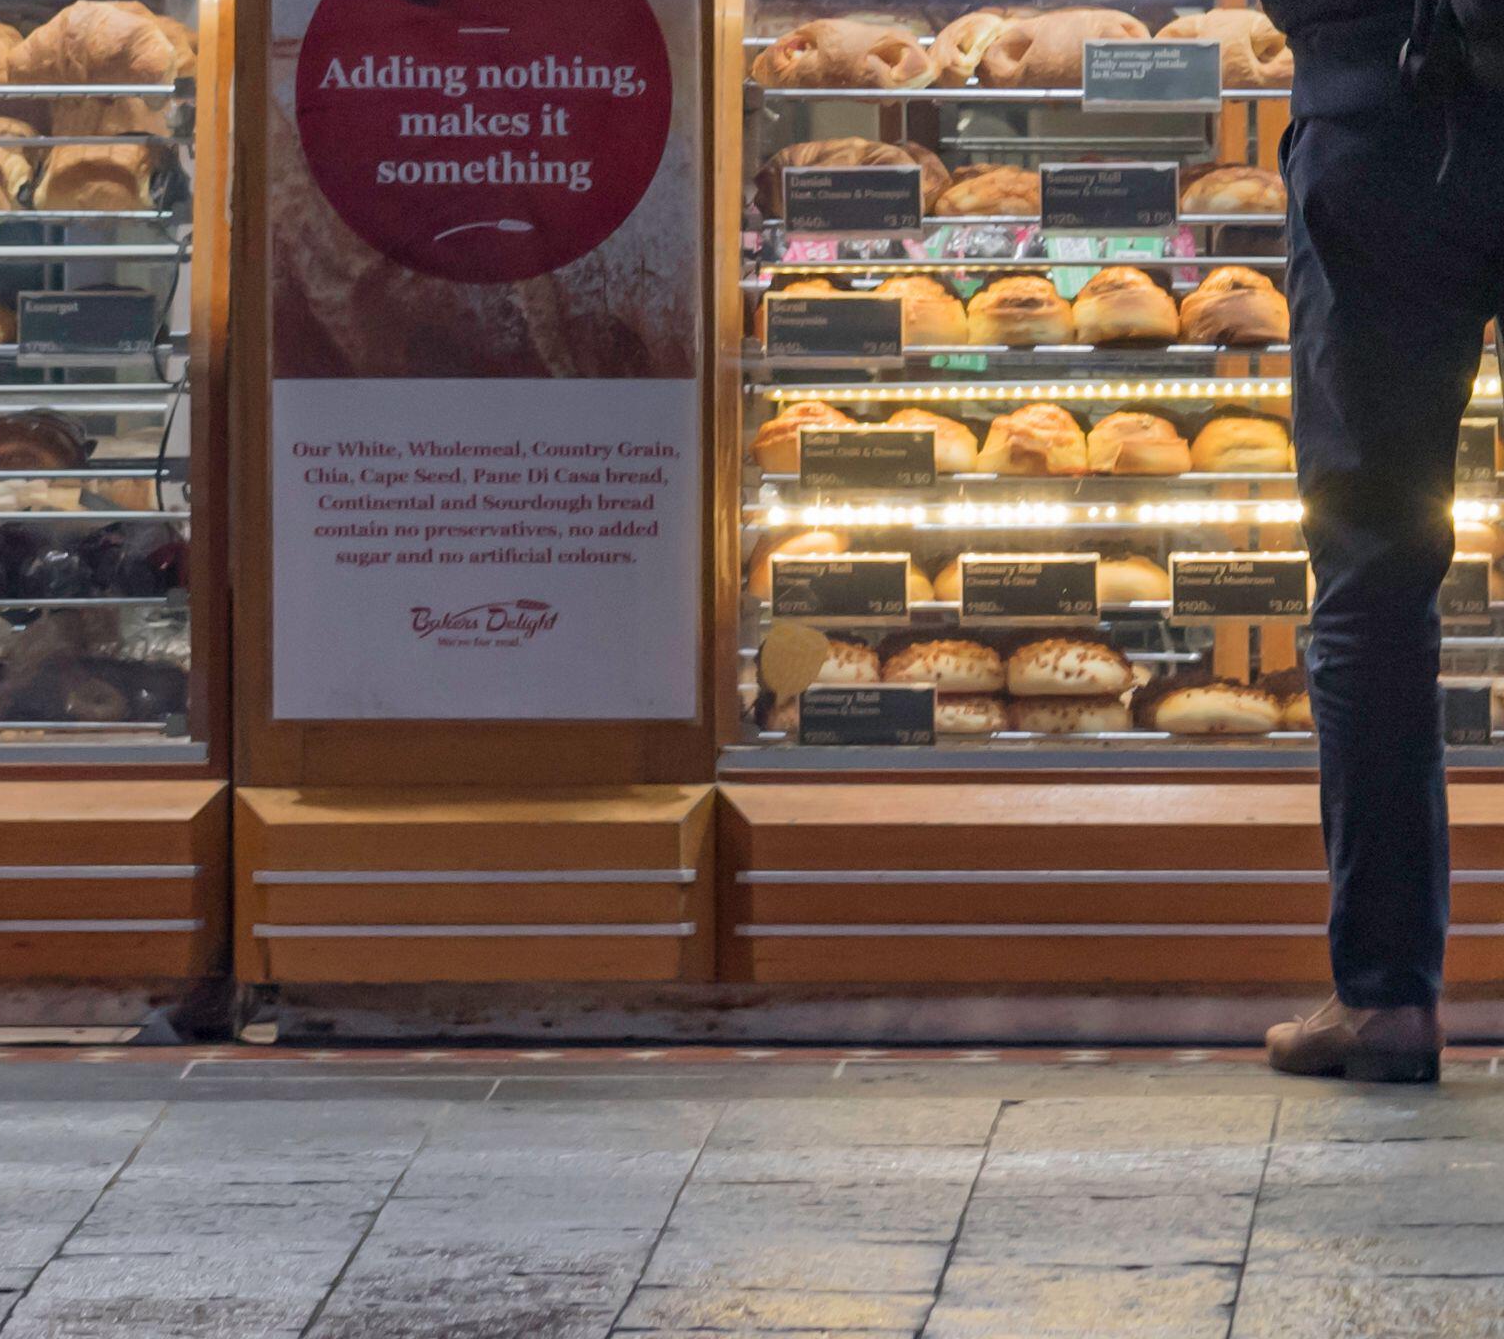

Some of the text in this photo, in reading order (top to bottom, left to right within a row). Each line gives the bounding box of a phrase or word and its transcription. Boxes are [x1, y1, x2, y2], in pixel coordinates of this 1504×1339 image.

[319, 55, 647, 97] Adding nothing,
[400, 104, 569, 137] makes it
[376, 151, 592, 192] something
[292, 441, 681, 461] Our White, Wholemeal, Country Grain,
[304, 468, 669, 487] Chia, Cape Seed, Pane Di Casa bread,
[319, 494, 655, 514] Continental and Sourdough bread
[314, 521, 659, 541] contain no preservatives, no added
[335, 548, 637, 567] sugar and no artificial colours.
[410, 606, 559, 639] Bakers Delight
